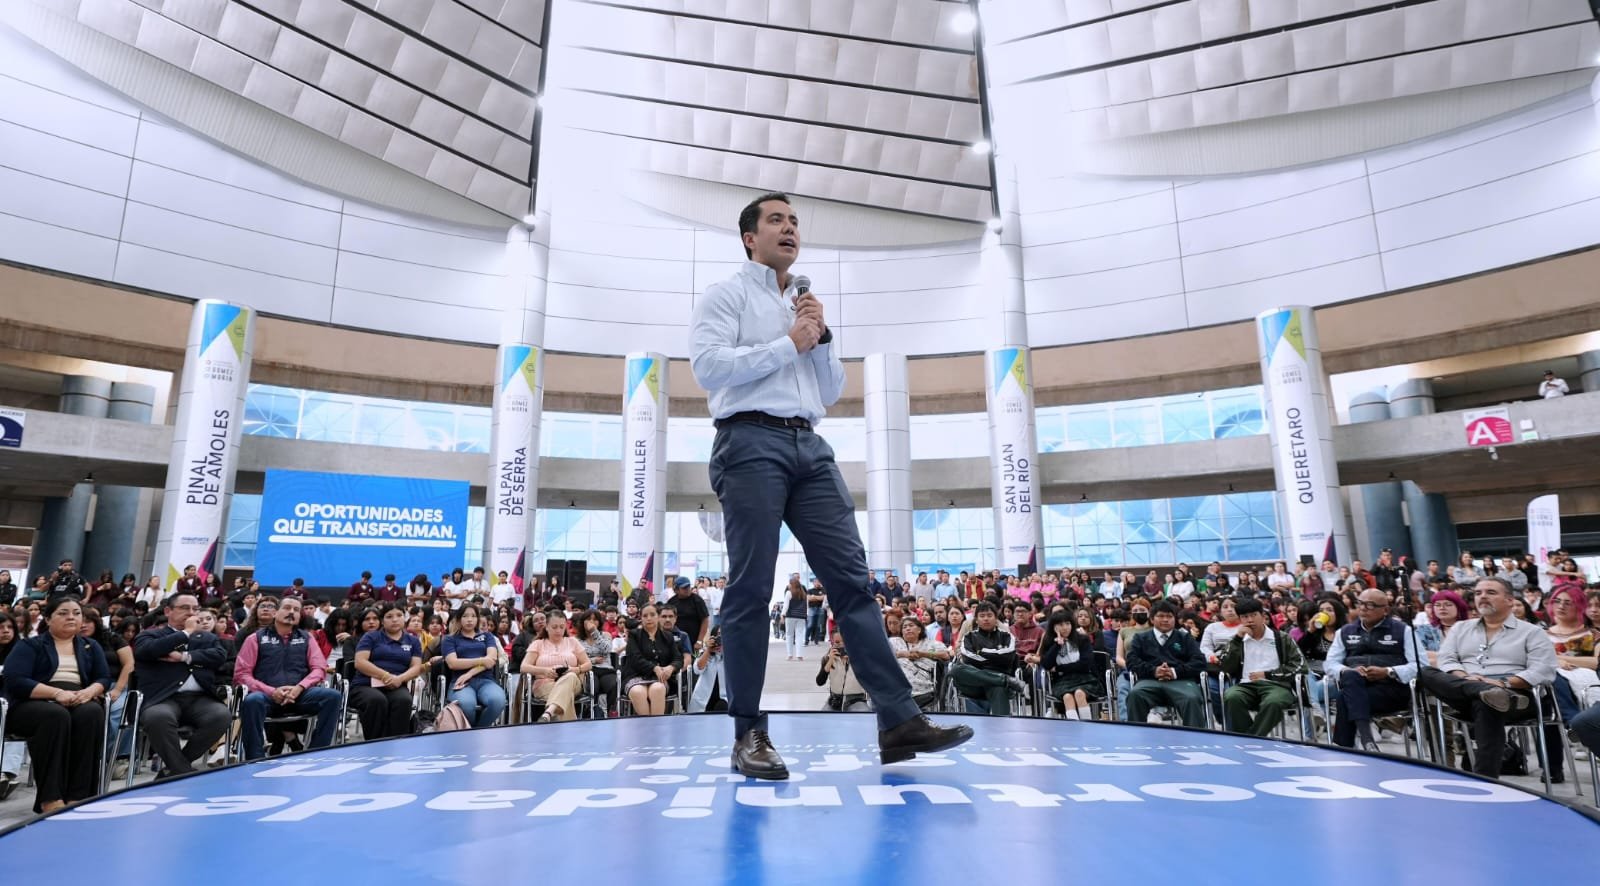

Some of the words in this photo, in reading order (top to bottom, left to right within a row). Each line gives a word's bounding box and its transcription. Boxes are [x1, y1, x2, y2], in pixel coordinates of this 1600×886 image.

[207, 409, 230, 479] AMOLES
[1470, 421, 1500, 445] A
[513, 447, 527, 493] SERRA
[1002, 443, 1015, 481] JUAN
[1286, 407, 1314, 504] QUERÉTARO
[186, 456, 207, 504] PINAL
[203, 483, 219, 505] DE
[499, 461, 513, 515] JALPAN
[630, 439, 647, 527] PEÑAMILLER
[294, 503, 443, 523] OPORTUNIDADES
[512, 496, 524, 515] DE
[1005, 486, 1017, 514] SAN
[1018, 487, 1031, 513] DEL
[273, 519, 315, 534] QUE
[319, 520, 457, 539] TRANSFORMAN.
[45, 775, 1541, 822] Oportunidades
